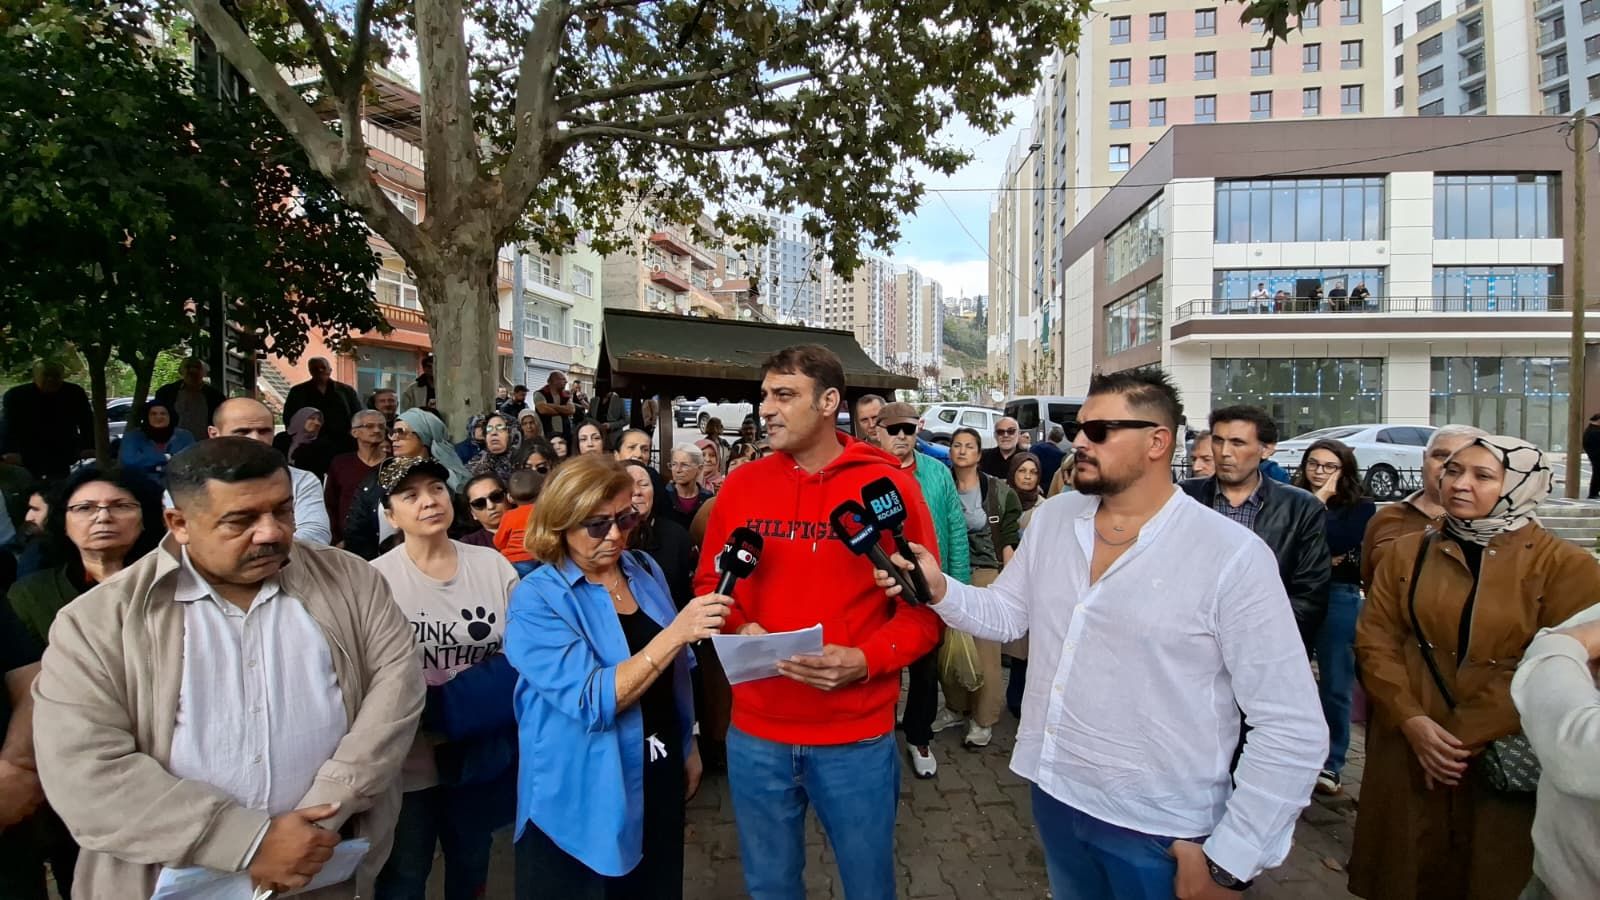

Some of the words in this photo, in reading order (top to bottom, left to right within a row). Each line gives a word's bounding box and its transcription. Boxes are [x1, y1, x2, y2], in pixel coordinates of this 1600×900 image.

[870, 493, 892, 514] BU
[746, 518, 841, 540] HILFIGE
[422, 641, 499, 669] NTHER
